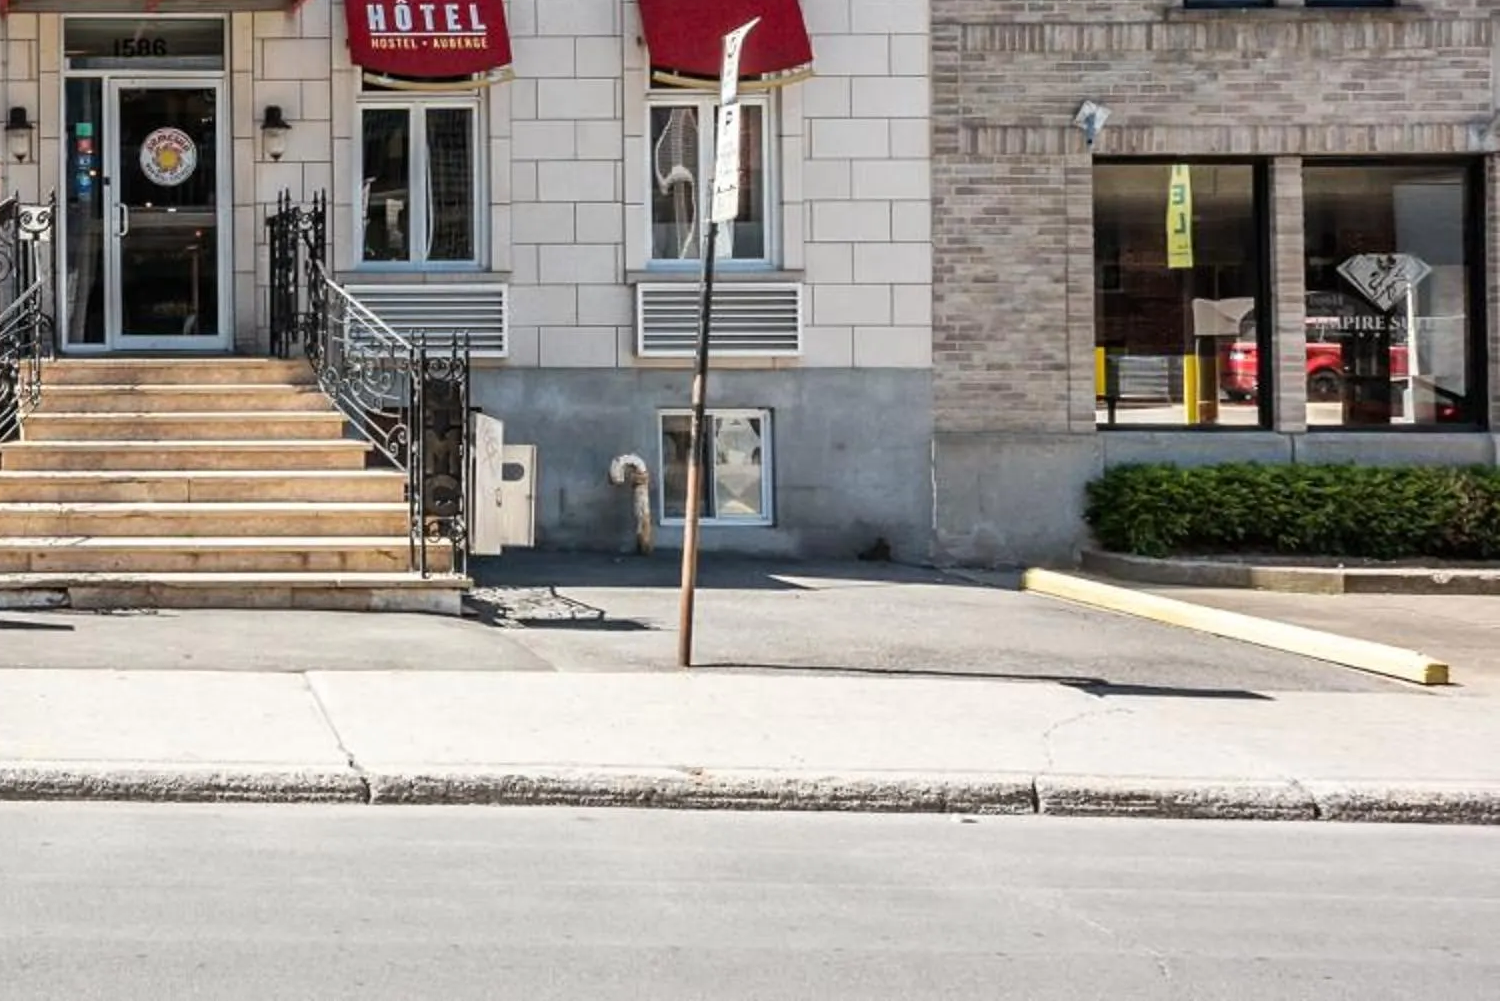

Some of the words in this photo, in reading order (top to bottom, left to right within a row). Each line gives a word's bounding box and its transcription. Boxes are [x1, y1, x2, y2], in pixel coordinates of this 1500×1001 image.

[114, 37, 168, 56] 1586
[371, 37, 418, 49] HOSTEL
[433, 37, 488, 49] AUBERGE
